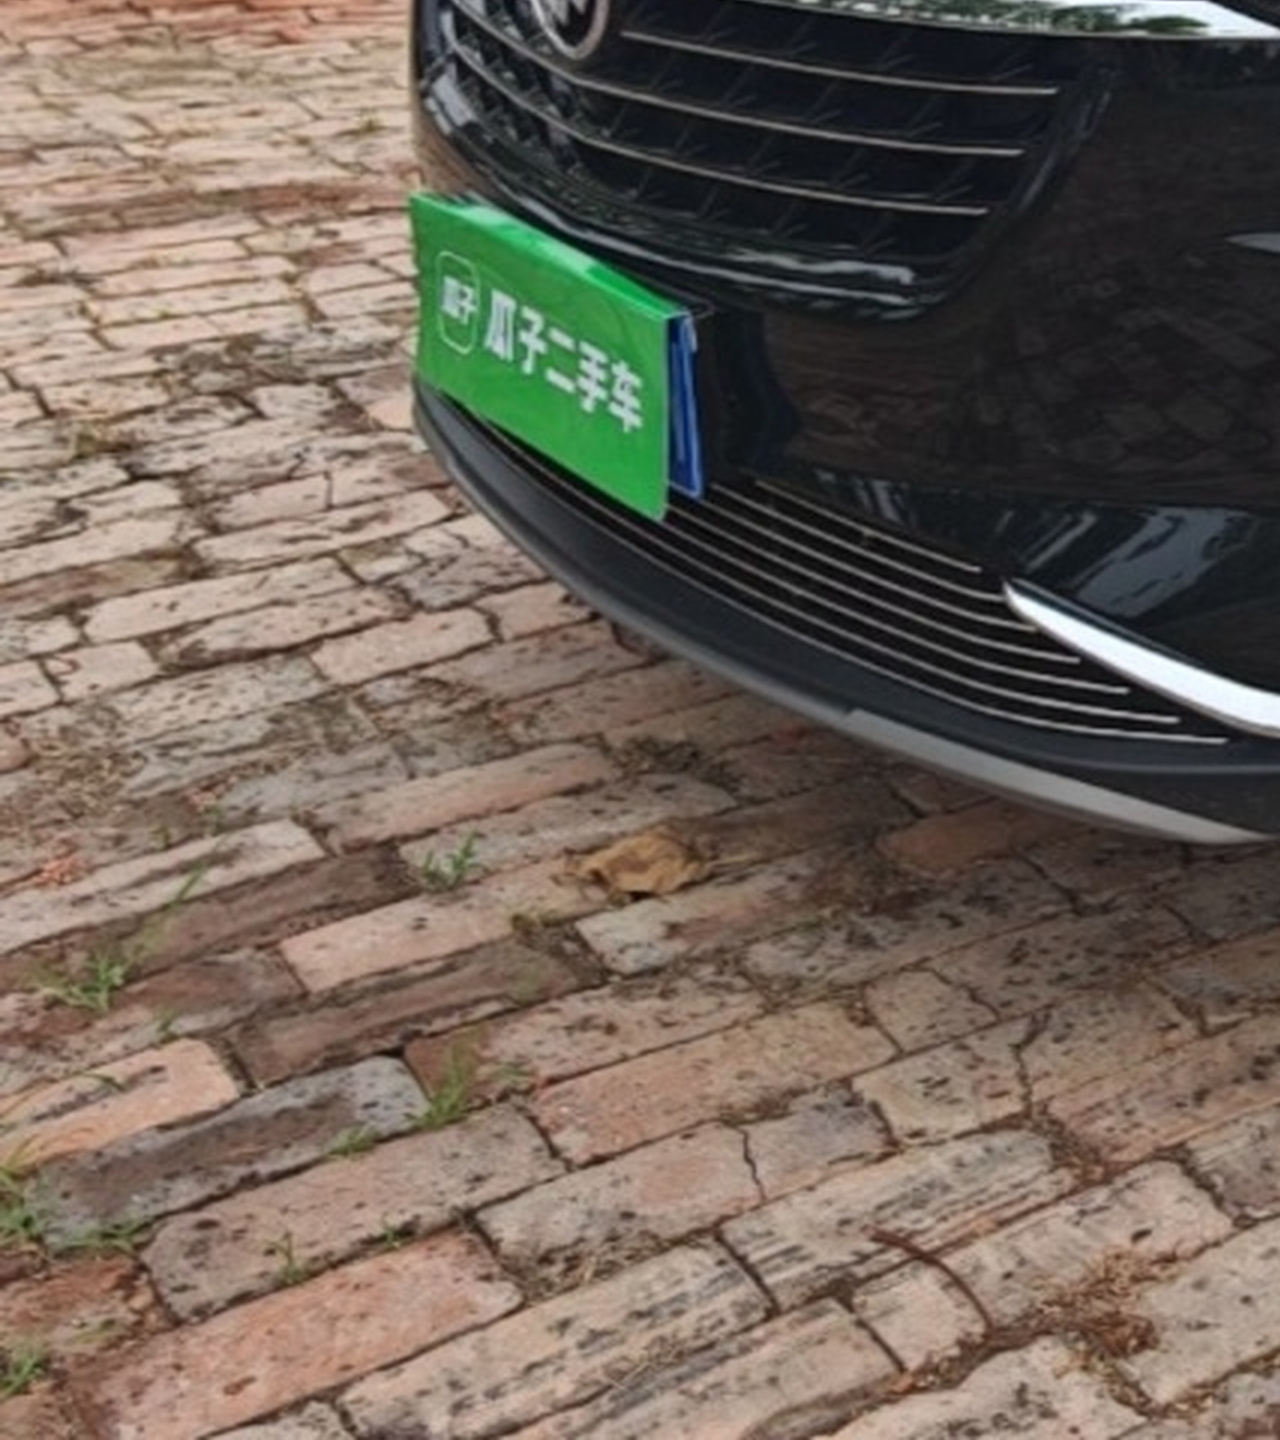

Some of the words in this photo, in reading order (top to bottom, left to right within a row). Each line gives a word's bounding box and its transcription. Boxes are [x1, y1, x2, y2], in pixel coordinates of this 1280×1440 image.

[484, 288, 643, 433] 瓜子二手车
